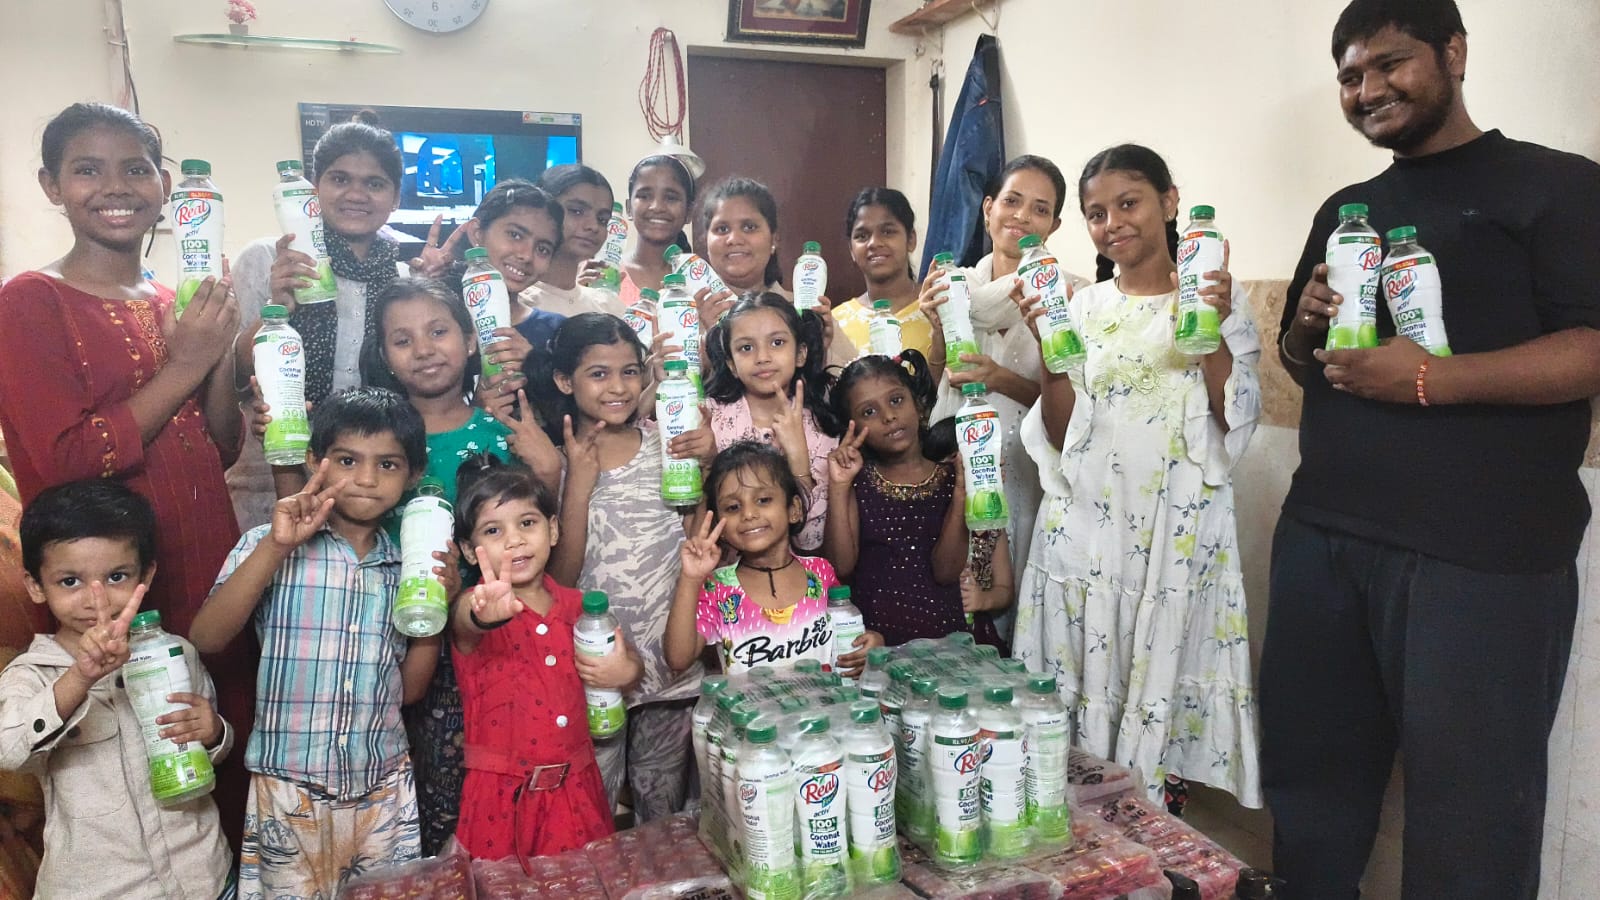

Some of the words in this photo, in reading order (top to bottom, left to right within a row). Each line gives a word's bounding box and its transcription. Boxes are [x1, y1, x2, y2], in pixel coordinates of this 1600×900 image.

[179, 200, 208, 226] Real
[1035, 265, 1056, 291] Real
[1388, 270, 1413, 301] Real
[967, 420, 989, 446] Real
[971, 467, 997, 475] Coconut
[733, 628, 833, 668] Barbie
[806, 774, 836, 805] Real
[810, 831, 840, 841] Coconut
[815, 840, 838, 849] Water
